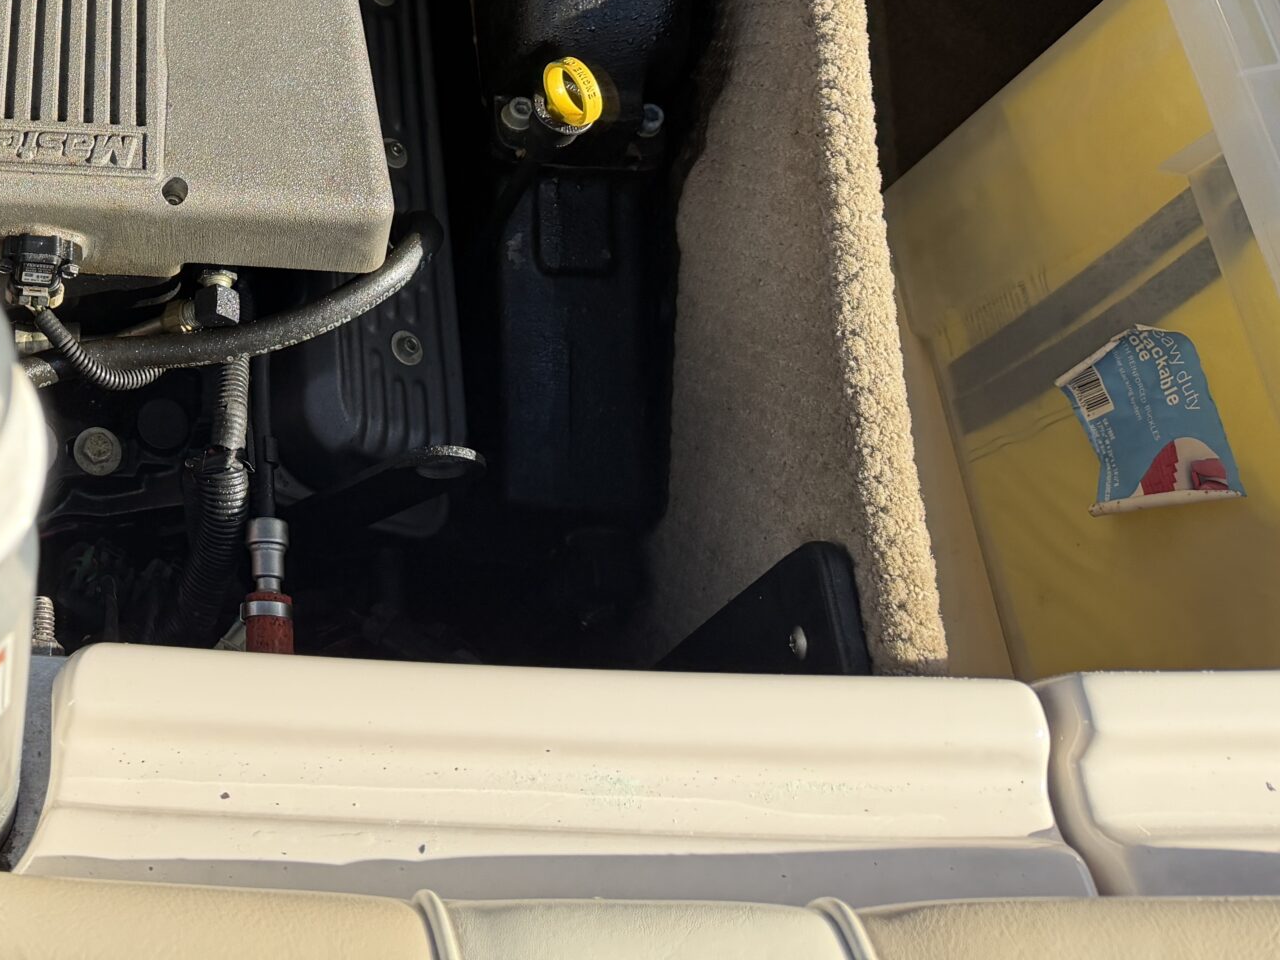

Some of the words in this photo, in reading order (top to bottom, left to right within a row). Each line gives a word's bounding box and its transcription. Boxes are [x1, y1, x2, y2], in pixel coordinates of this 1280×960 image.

[319, 315, 351, 335] MADE
[1128, 354, 1147, 404] REINFORCED
[1152, 329, 1184, 365] eavy
[1176, 371, 1201, 410] duty
